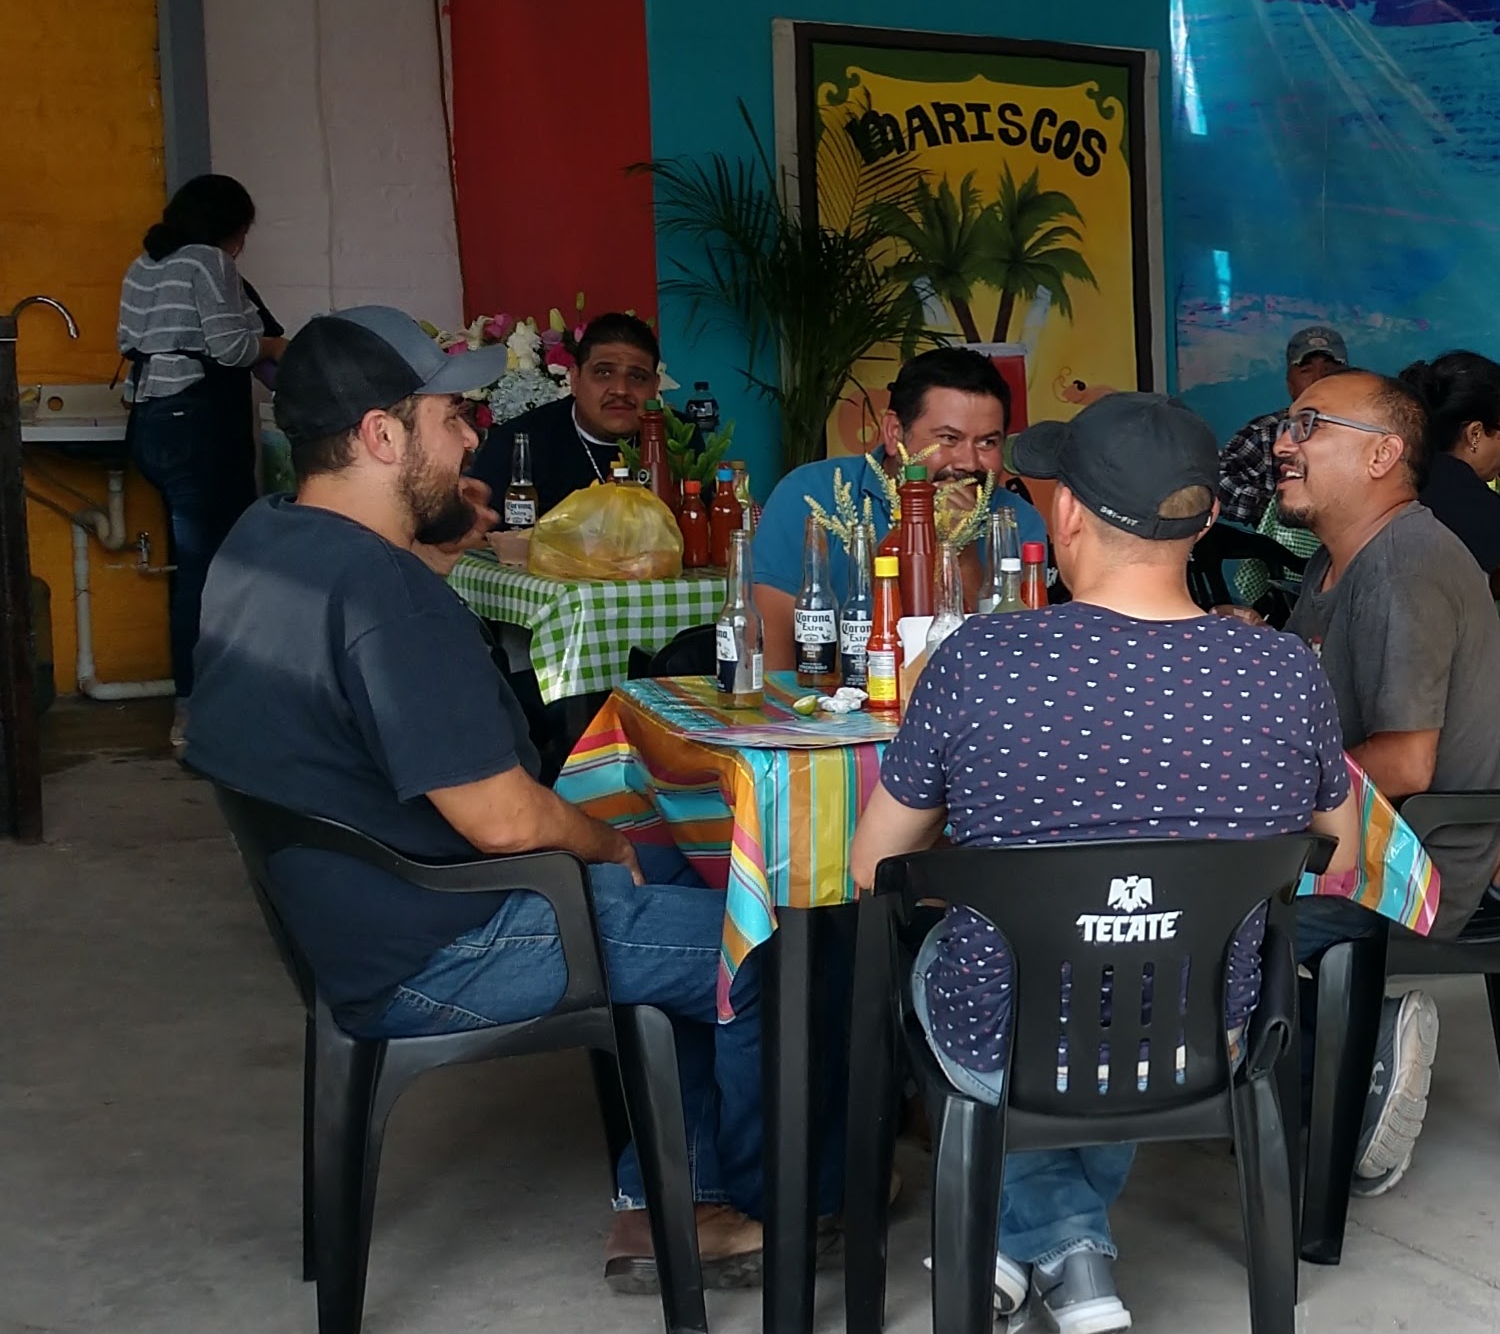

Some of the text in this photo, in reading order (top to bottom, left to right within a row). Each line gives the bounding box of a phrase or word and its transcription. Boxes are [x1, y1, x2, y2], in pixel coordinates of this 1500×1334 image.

[845, 101, 1107, 177] MARISCOS
[795, 611, 831, 624] Corona
[802, 623, 824, 631] Extra
[841, 622, 872, 634] Coron
[849, 634, 868, 642] Extr
[1125, 886, 1137, 899] T
[1076, 910, 1183, 943] TECATE
